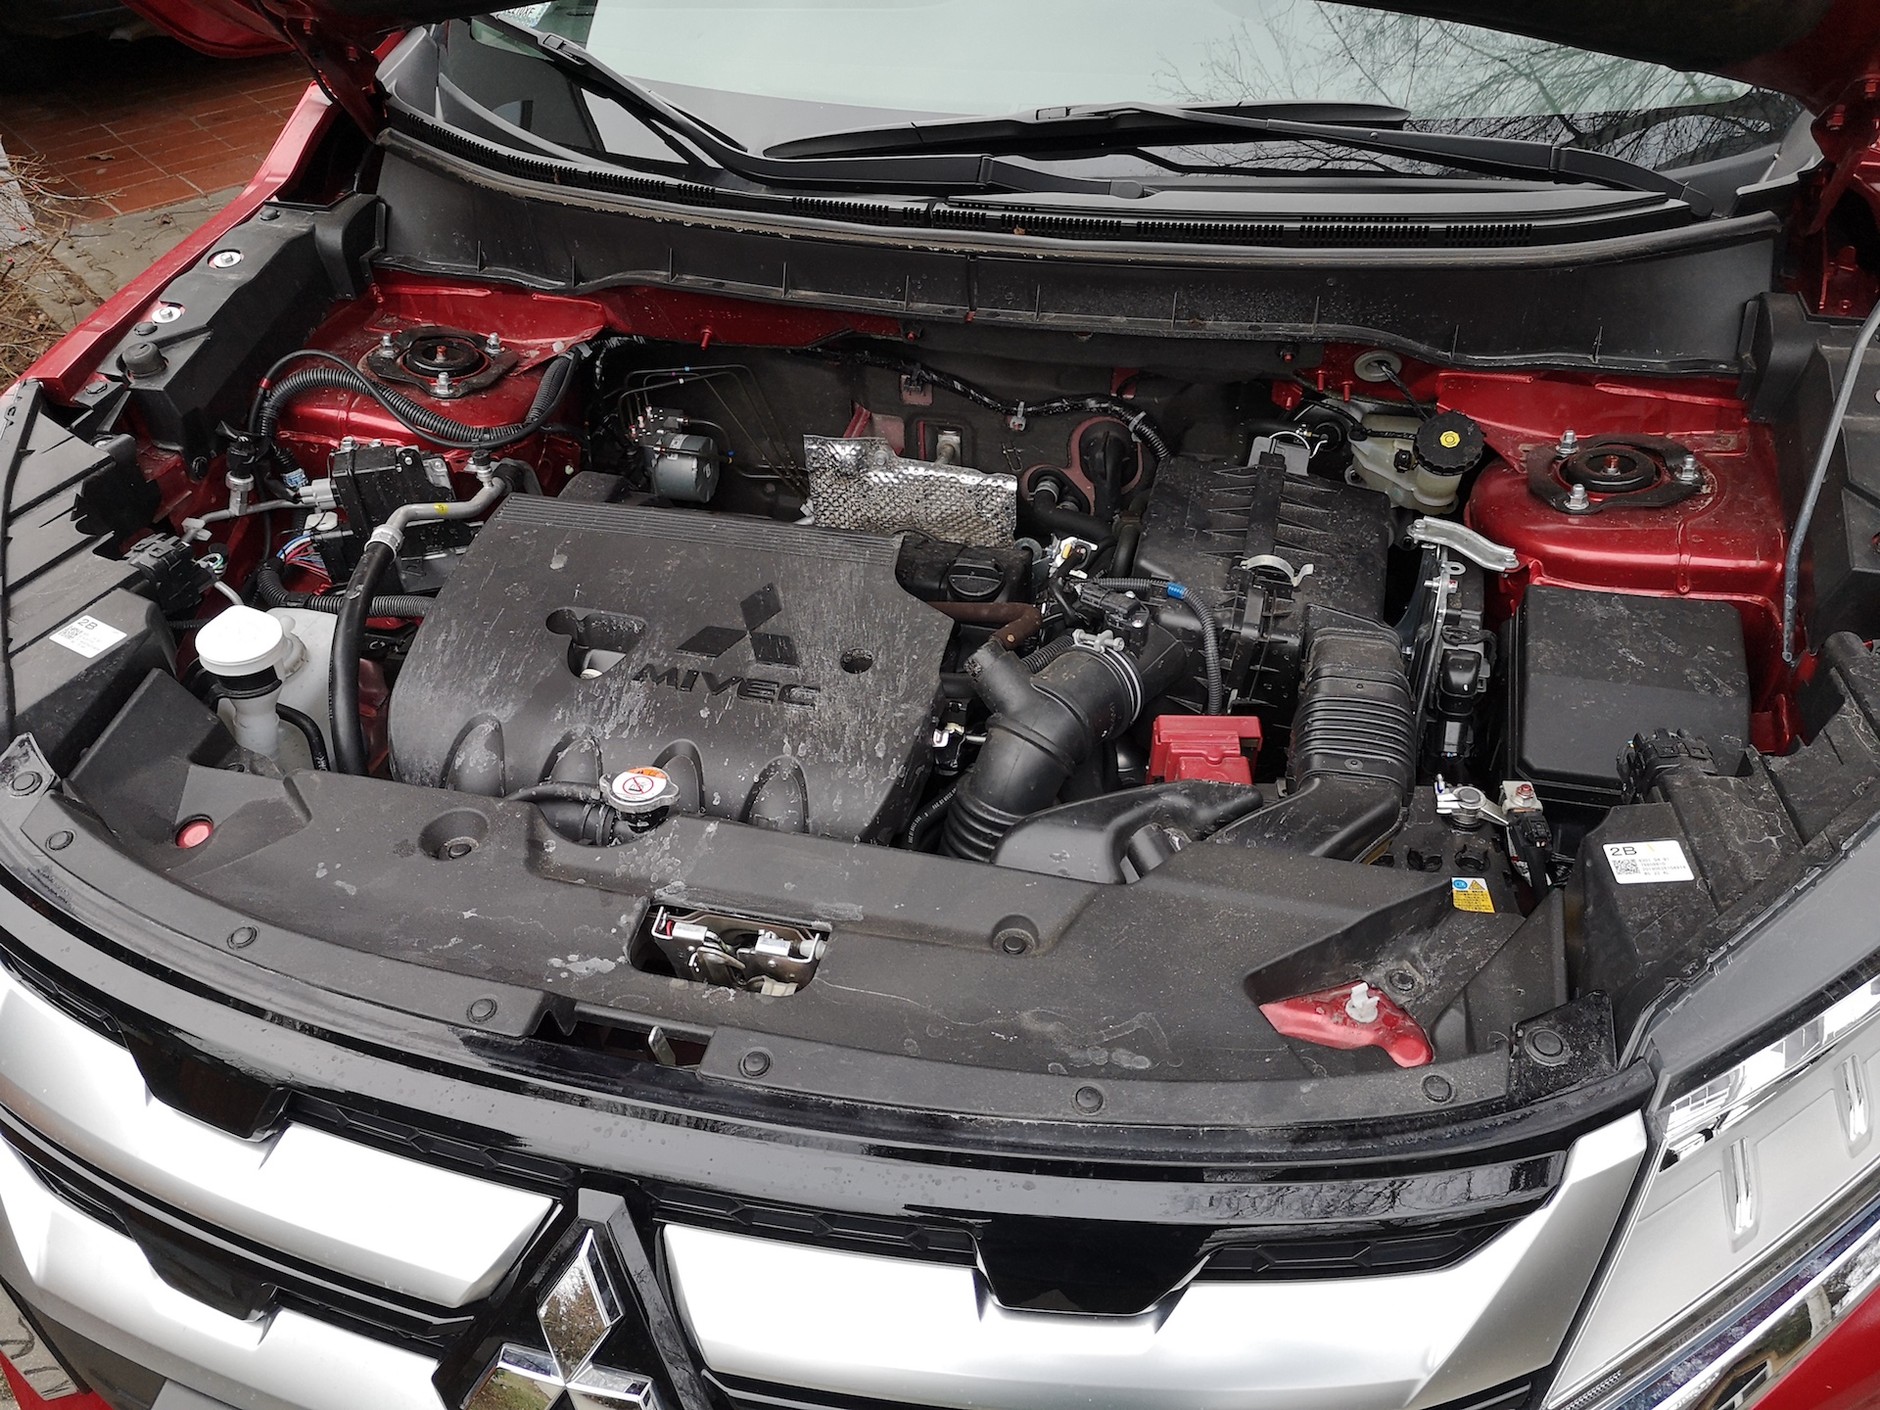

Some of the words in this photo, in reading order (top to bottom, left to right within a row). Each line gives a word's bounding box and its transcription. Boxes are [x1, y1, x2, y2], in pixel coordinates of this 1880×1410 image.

[78, 619, 98, 630] 2B
[630, 662, 821, 711] MIVEC
[1610, 846, 1637, 856] 2B
